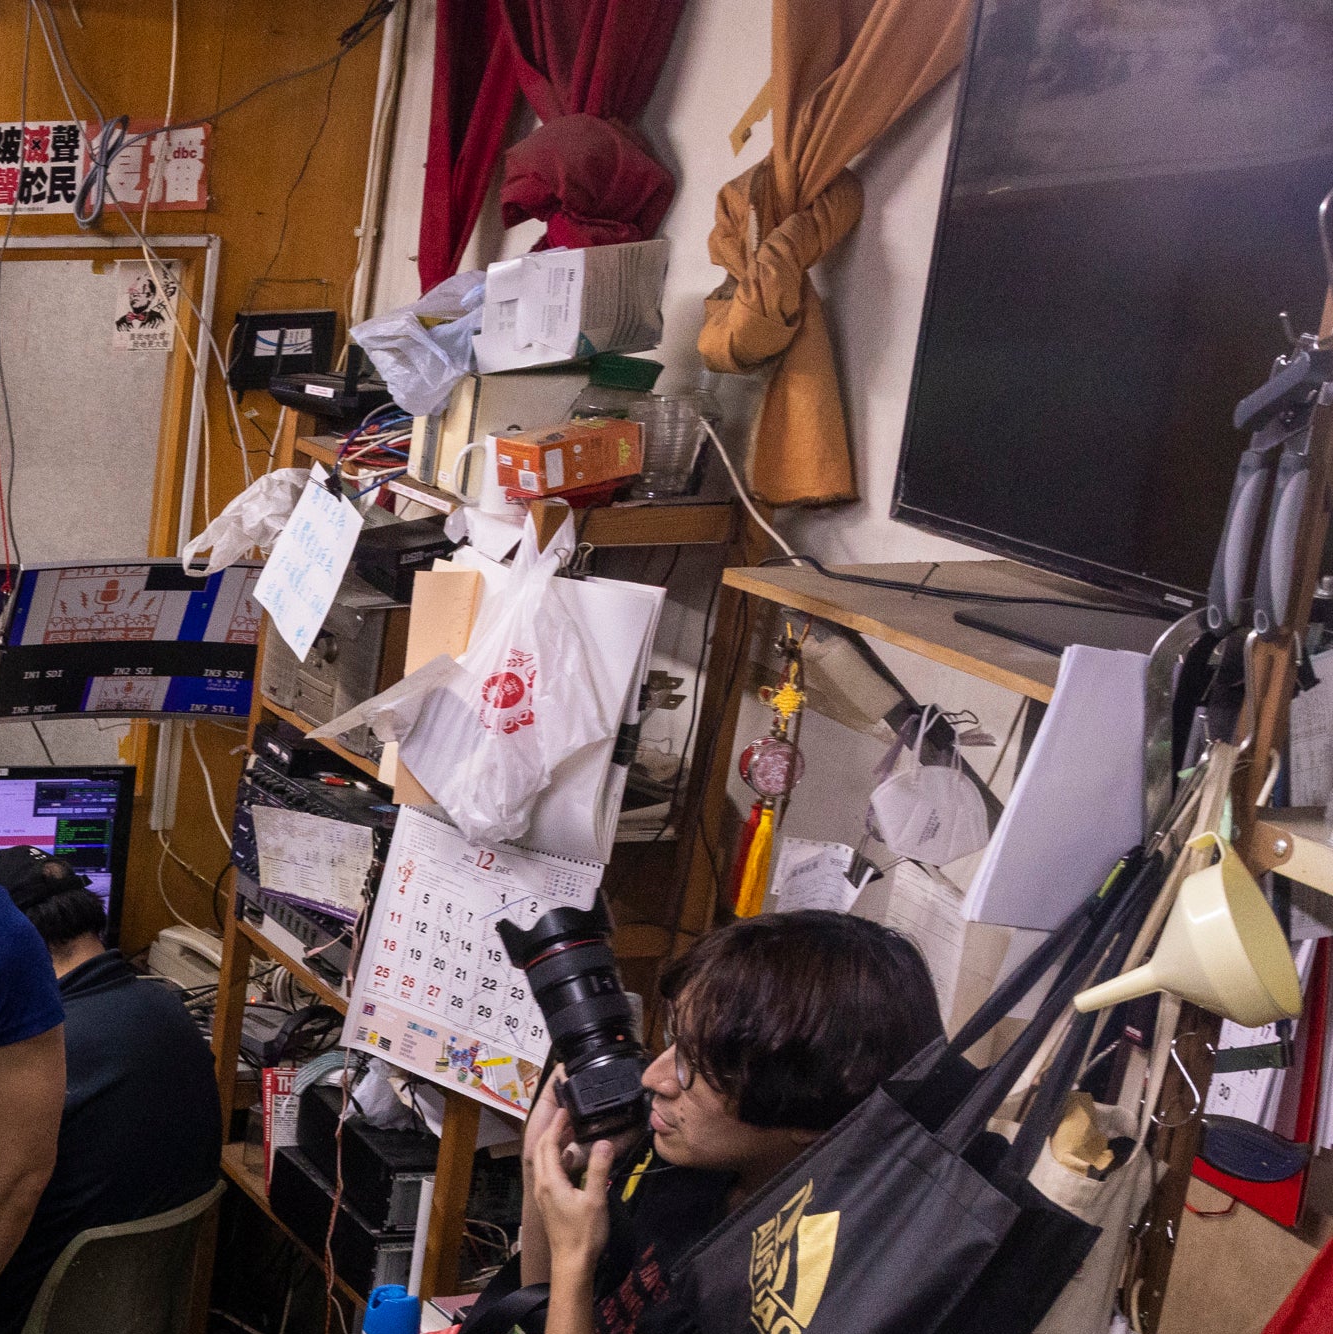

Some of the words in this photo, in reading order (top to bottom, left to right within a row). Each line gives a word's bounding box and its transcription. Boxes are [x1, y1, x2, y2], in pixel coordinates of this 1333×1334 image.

[172, 147, 197, 159] dbc
[23, 671, 40, 680] IN1
[45, 670, 64, 678] SDI
[113, 667, 130, 675] IN2
[135, 667, 154, 675] SDI
[203, 669, 221, 677] IN3
[226, 670, 245, 678] SDI
[34, 704, 57, 713] HDMI
[189, 704, 207, 712] IN7
[475, 850, 496, 871] 12
[495, 865, 514, 876] DEC
[398, 885, 406, 895] 4
[422, 893, 430, 904] 5
[445, 902, 452, 914] 6
[467, 912, 474, 923] 7
[501, 893, 507, 904] 1
[531, 902, 538, 913] 2
[390, 911, 402, 924] 11
[415, 920, 428, 934] 12
[440, 930, 451, 943] 13
[461, 940, 472, 952] 14
[487, 949, 502, 962] 15
[383, 938, 397, 951] 18
[410, 948, 422, 961] 19
[433, 957, 446, 971] 20
[455, 967, 467, 981] 21
[482, 977, 497, 991] 22
[510, 986, 525, 1001] 23
[375, 965, 390, 979] 25
[401, 975, 416, 988] 26
[428, 985, 442, 998] 27
[451, 995, 463, 1009] 28
[478, 1005, 492, 1018] 29
[505, 1015, 519, 1029] 30
[531, 1025, 544, 1039] 31
[277, 1076, 292, 1092] TH
